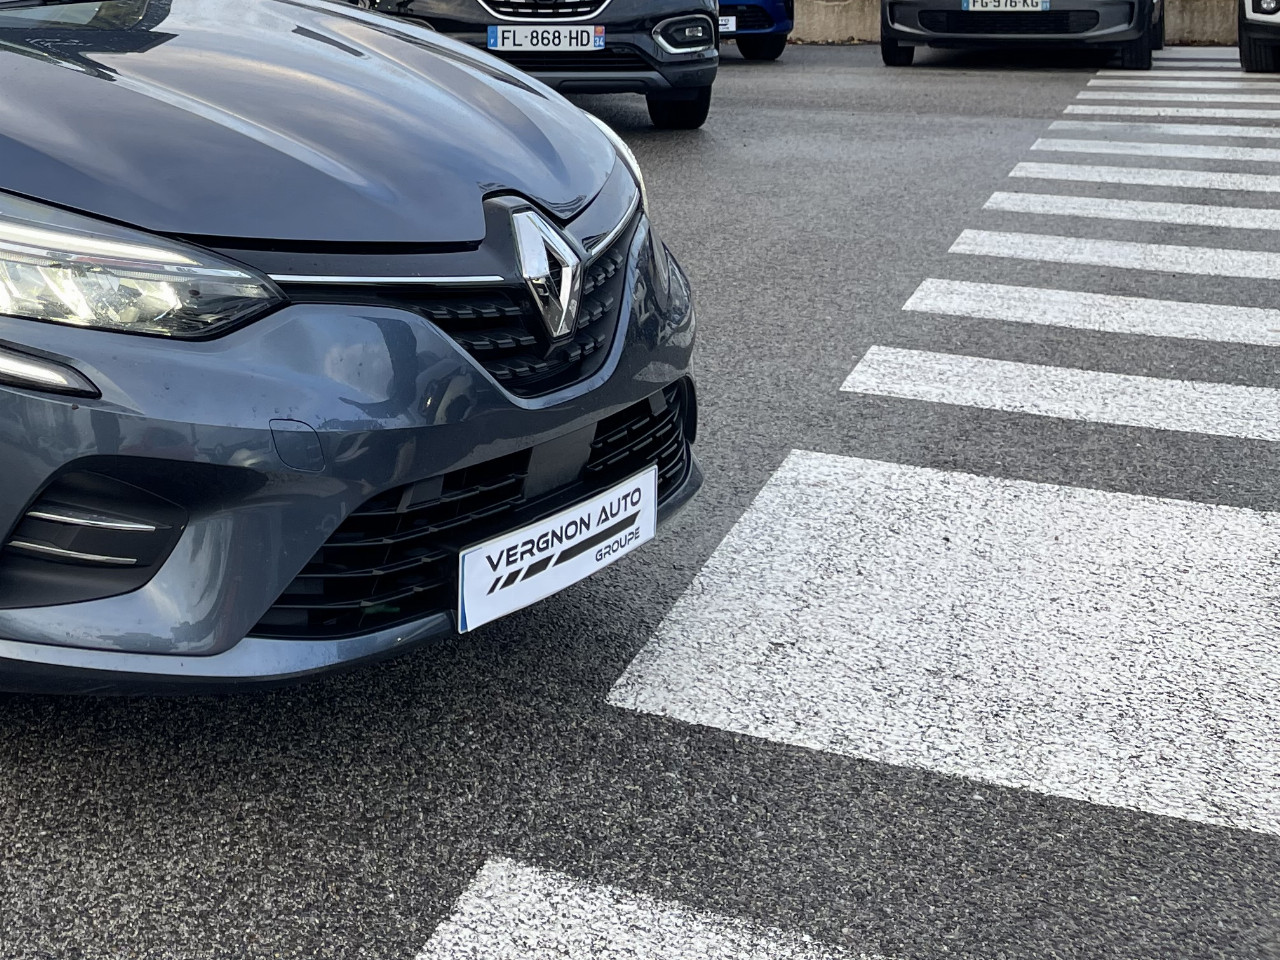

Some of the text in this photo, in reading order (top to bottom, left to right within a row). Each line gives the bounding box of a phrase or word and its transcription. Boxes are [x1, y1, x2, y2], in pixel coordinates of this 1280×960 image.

[501, 30, 591, 47] FL-868-HD
[594, 37, 605, 47] 34
[486, 487, 642, 573] VERGNON AUTO
[595, 526, 641, 563] GROUPE
